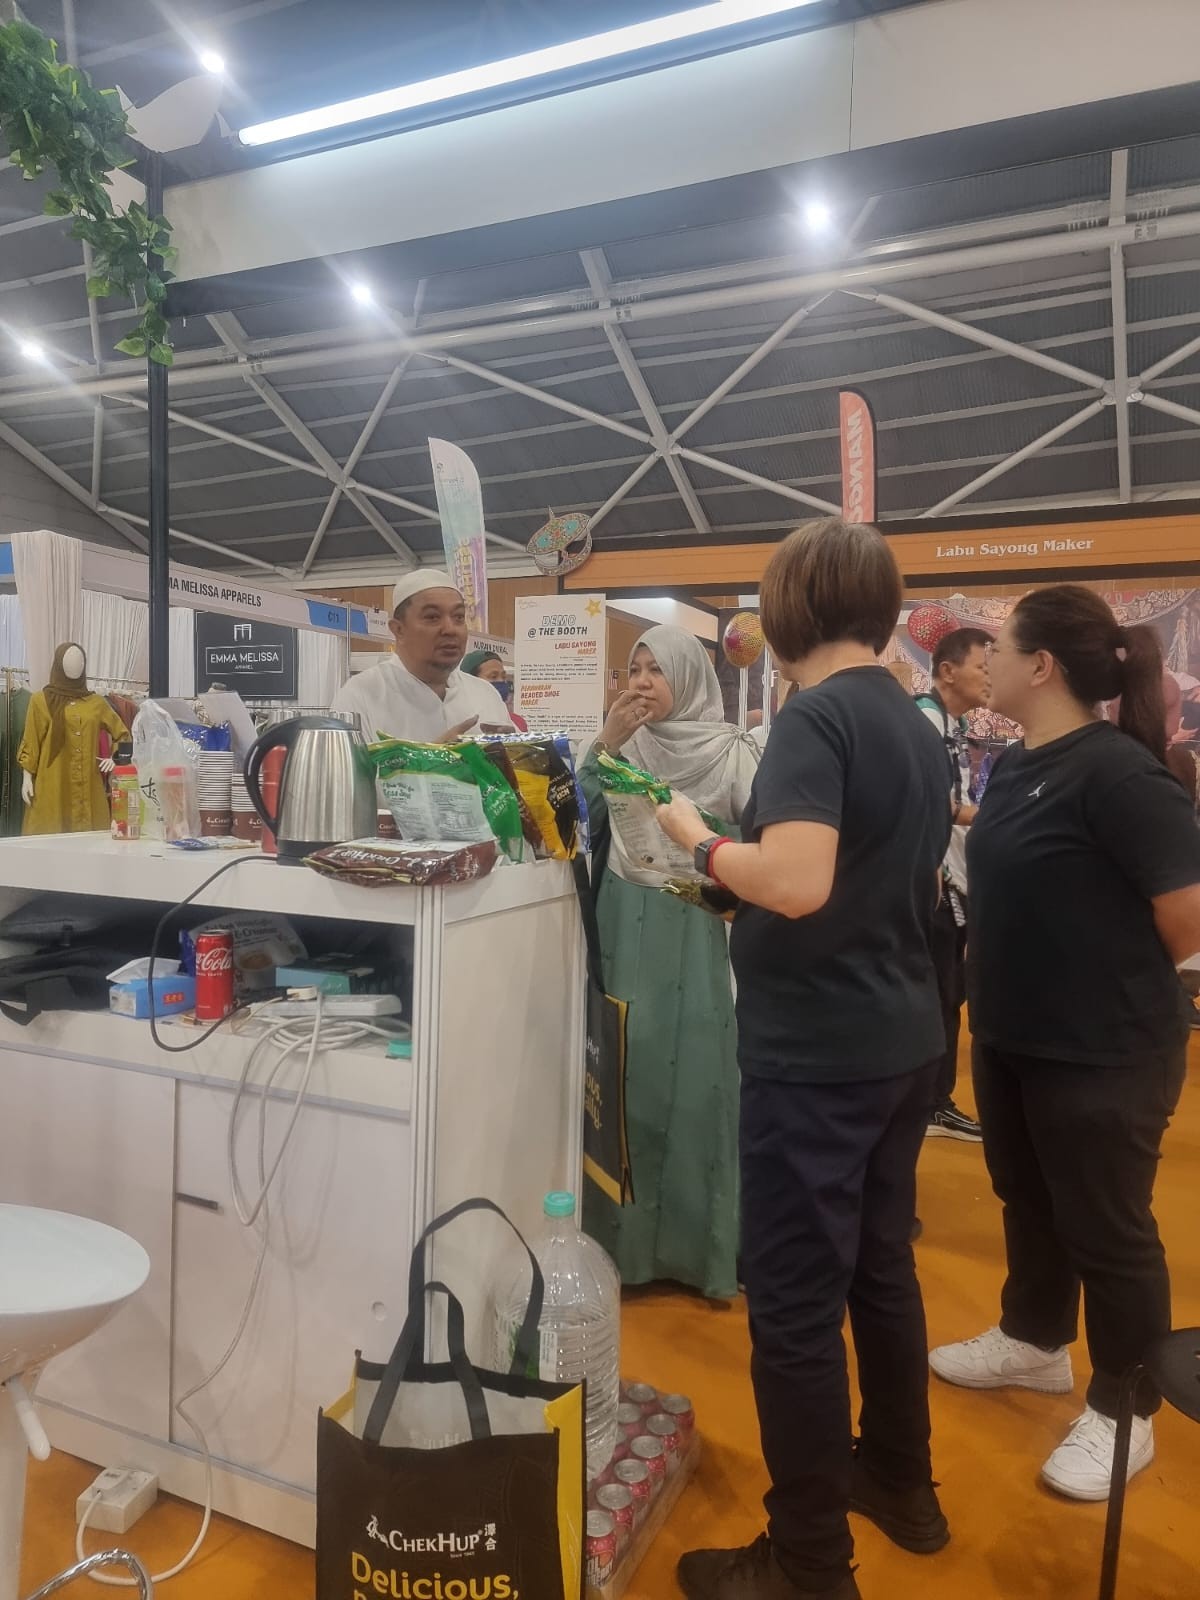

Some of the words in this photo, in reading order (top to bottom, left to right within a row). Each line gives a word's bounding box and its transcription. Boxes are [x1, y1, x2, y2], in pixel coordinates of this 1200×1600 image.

[936, 546, 975, 558] Labu
[980, 543, 1038, 557] Sayong
[1043, 539, 1094, 551] Maker
[181, 579, 219, 599] MELISSA
[221, 588, 262, 607] APPARELS
[542, 614, 577, 627] DEMO
[528, 627, 537, 638] @
[539, 627, 555, 636] THE
[557, 626, 588, 636] BOOTH
[210, 653, 238, 664] EMMA
[239, 651, 279, 662] MELISSA
[351, 1551, 519, 1600] Delicious,
